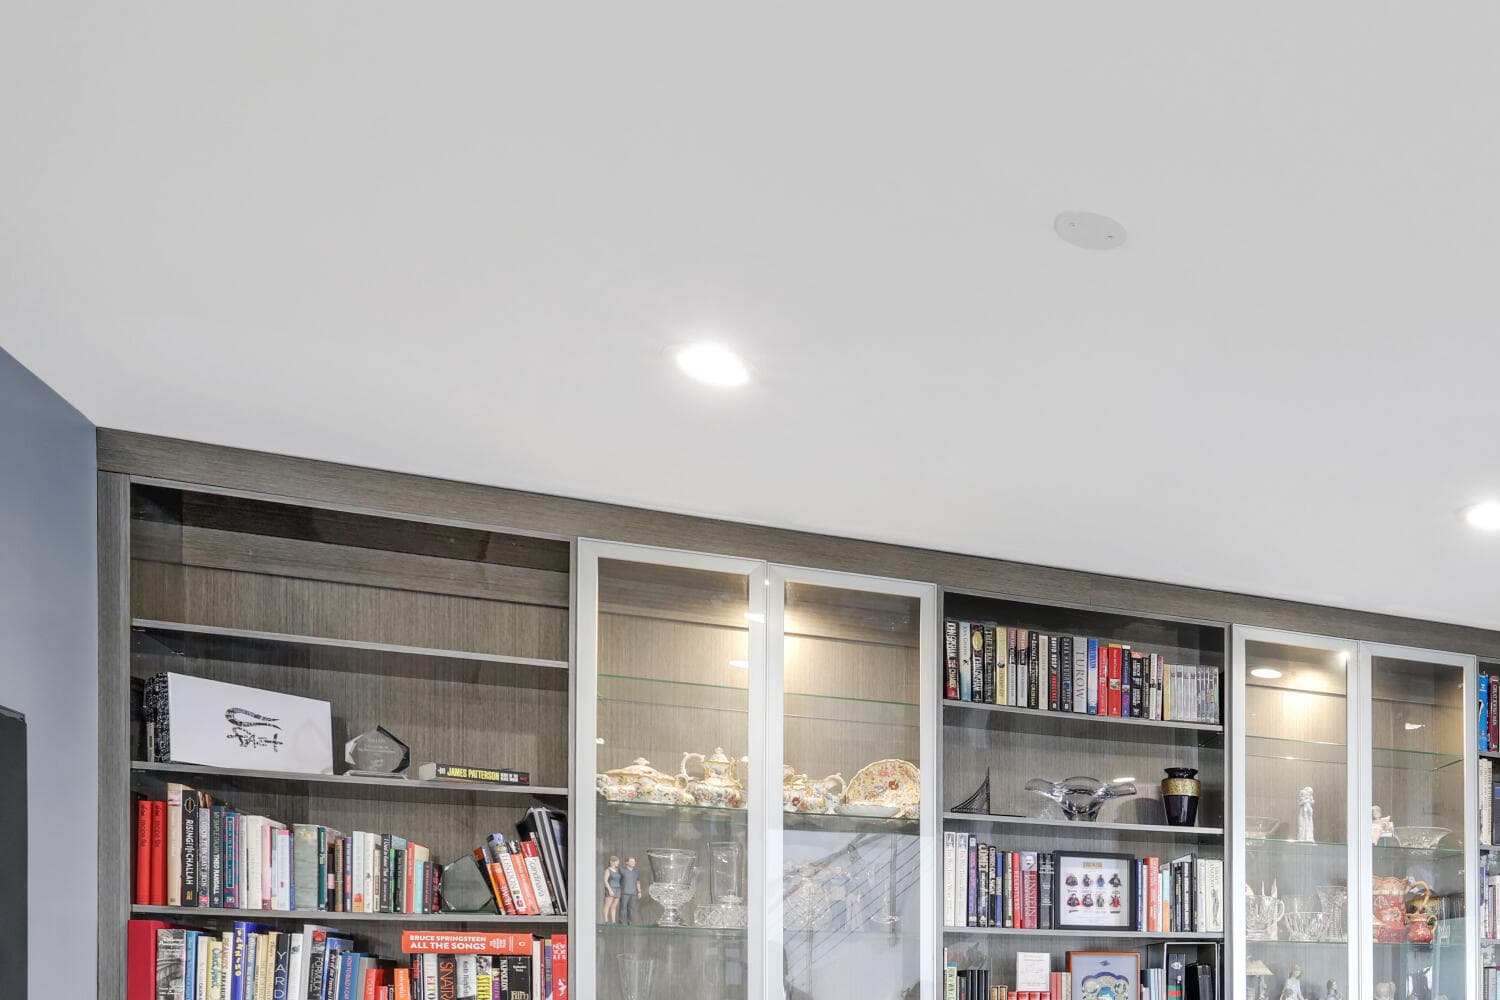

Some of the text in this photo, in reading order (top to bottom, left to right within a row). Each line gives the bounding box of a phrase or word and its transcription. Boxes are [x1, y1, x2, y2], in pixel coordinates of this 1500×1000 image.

[1075, 651, 1086, 700] TUROW
[446, 767, 500, 781] JAMES PATTERSON
[185, 854, 194, 885] CHALLAH
[1029, 875, 1038, 918] EINSTEIN
[410, 942, 429, 950] ALL
[430, 942, 450, 950] THE
[451, 942, 482, 951] SONGS
[274, 951, 287, 999] YARD
[312, 956, 323, 991] FORMULA
[477, 976, 491, 1000] STEVEN
[500, 959, 508, 991] NAPOLEON
